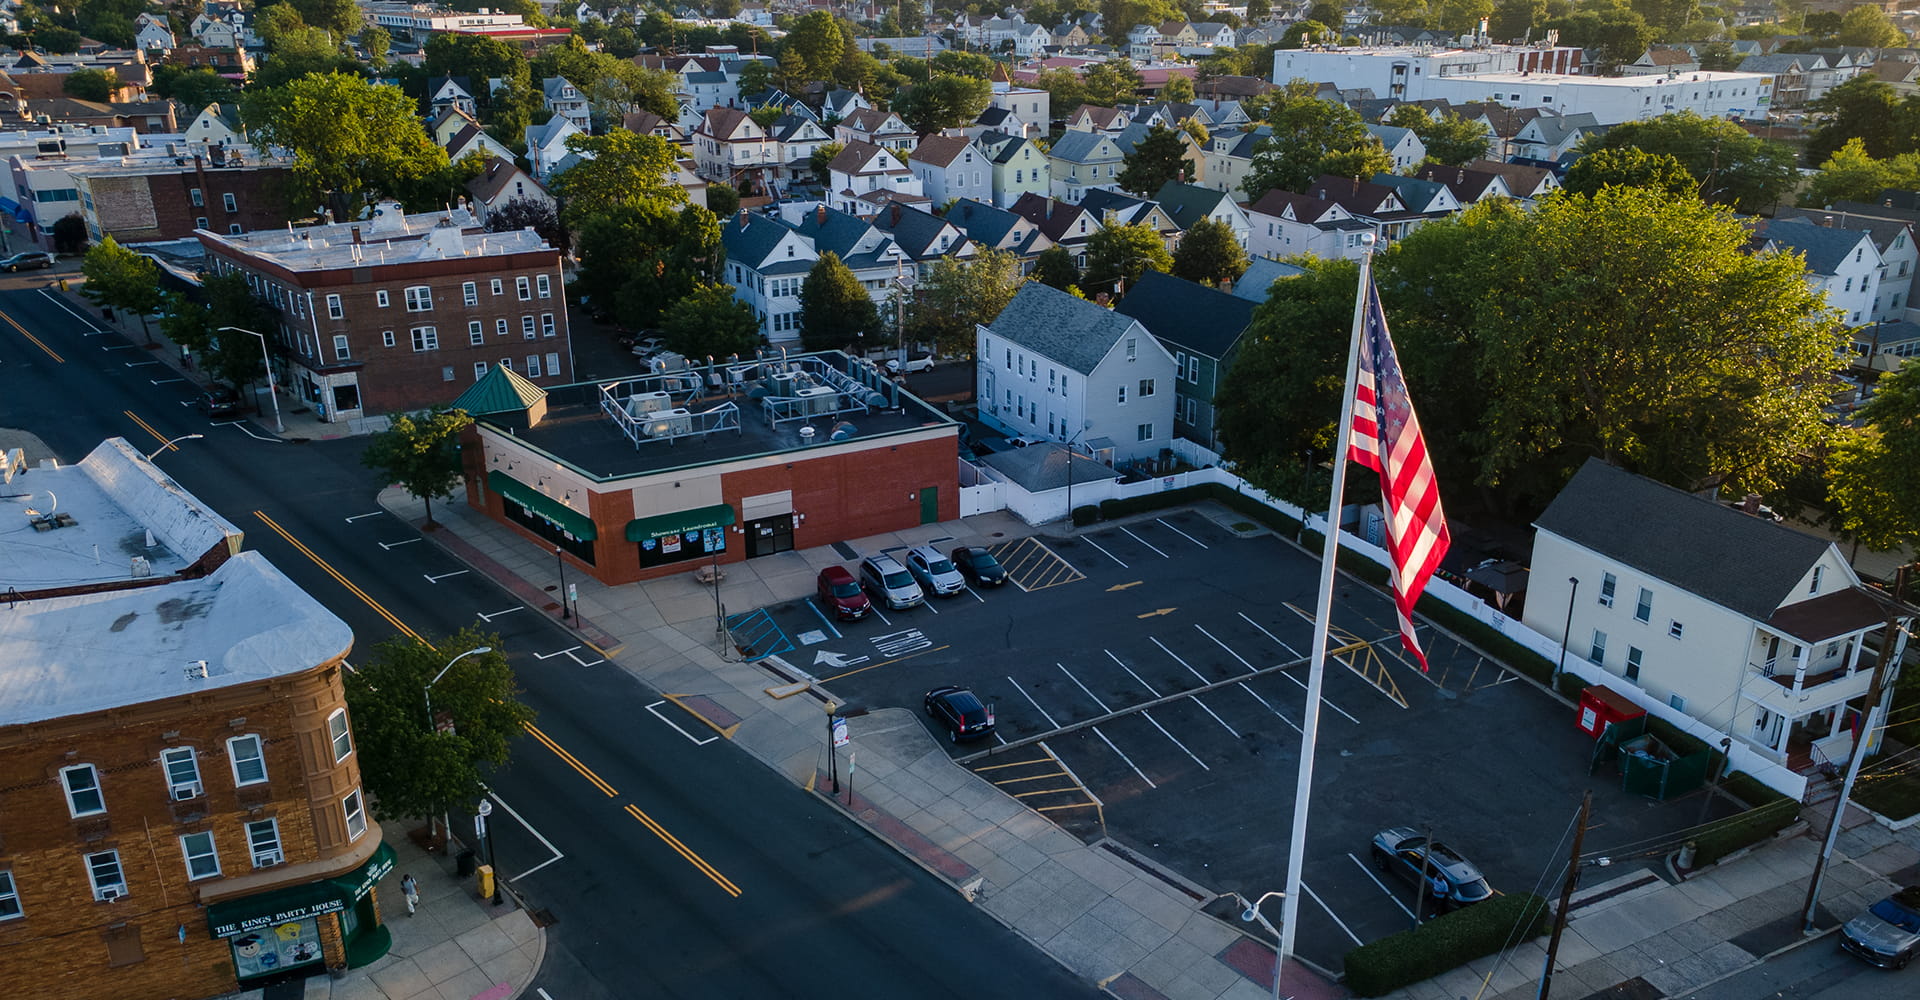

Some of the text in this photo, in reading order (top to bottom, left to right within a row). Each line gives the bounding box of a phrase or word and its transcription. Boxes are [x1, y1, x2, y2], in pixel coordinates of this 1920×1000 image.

[214, 899, 343, 934] THE KINGS PARTY HOUSE
